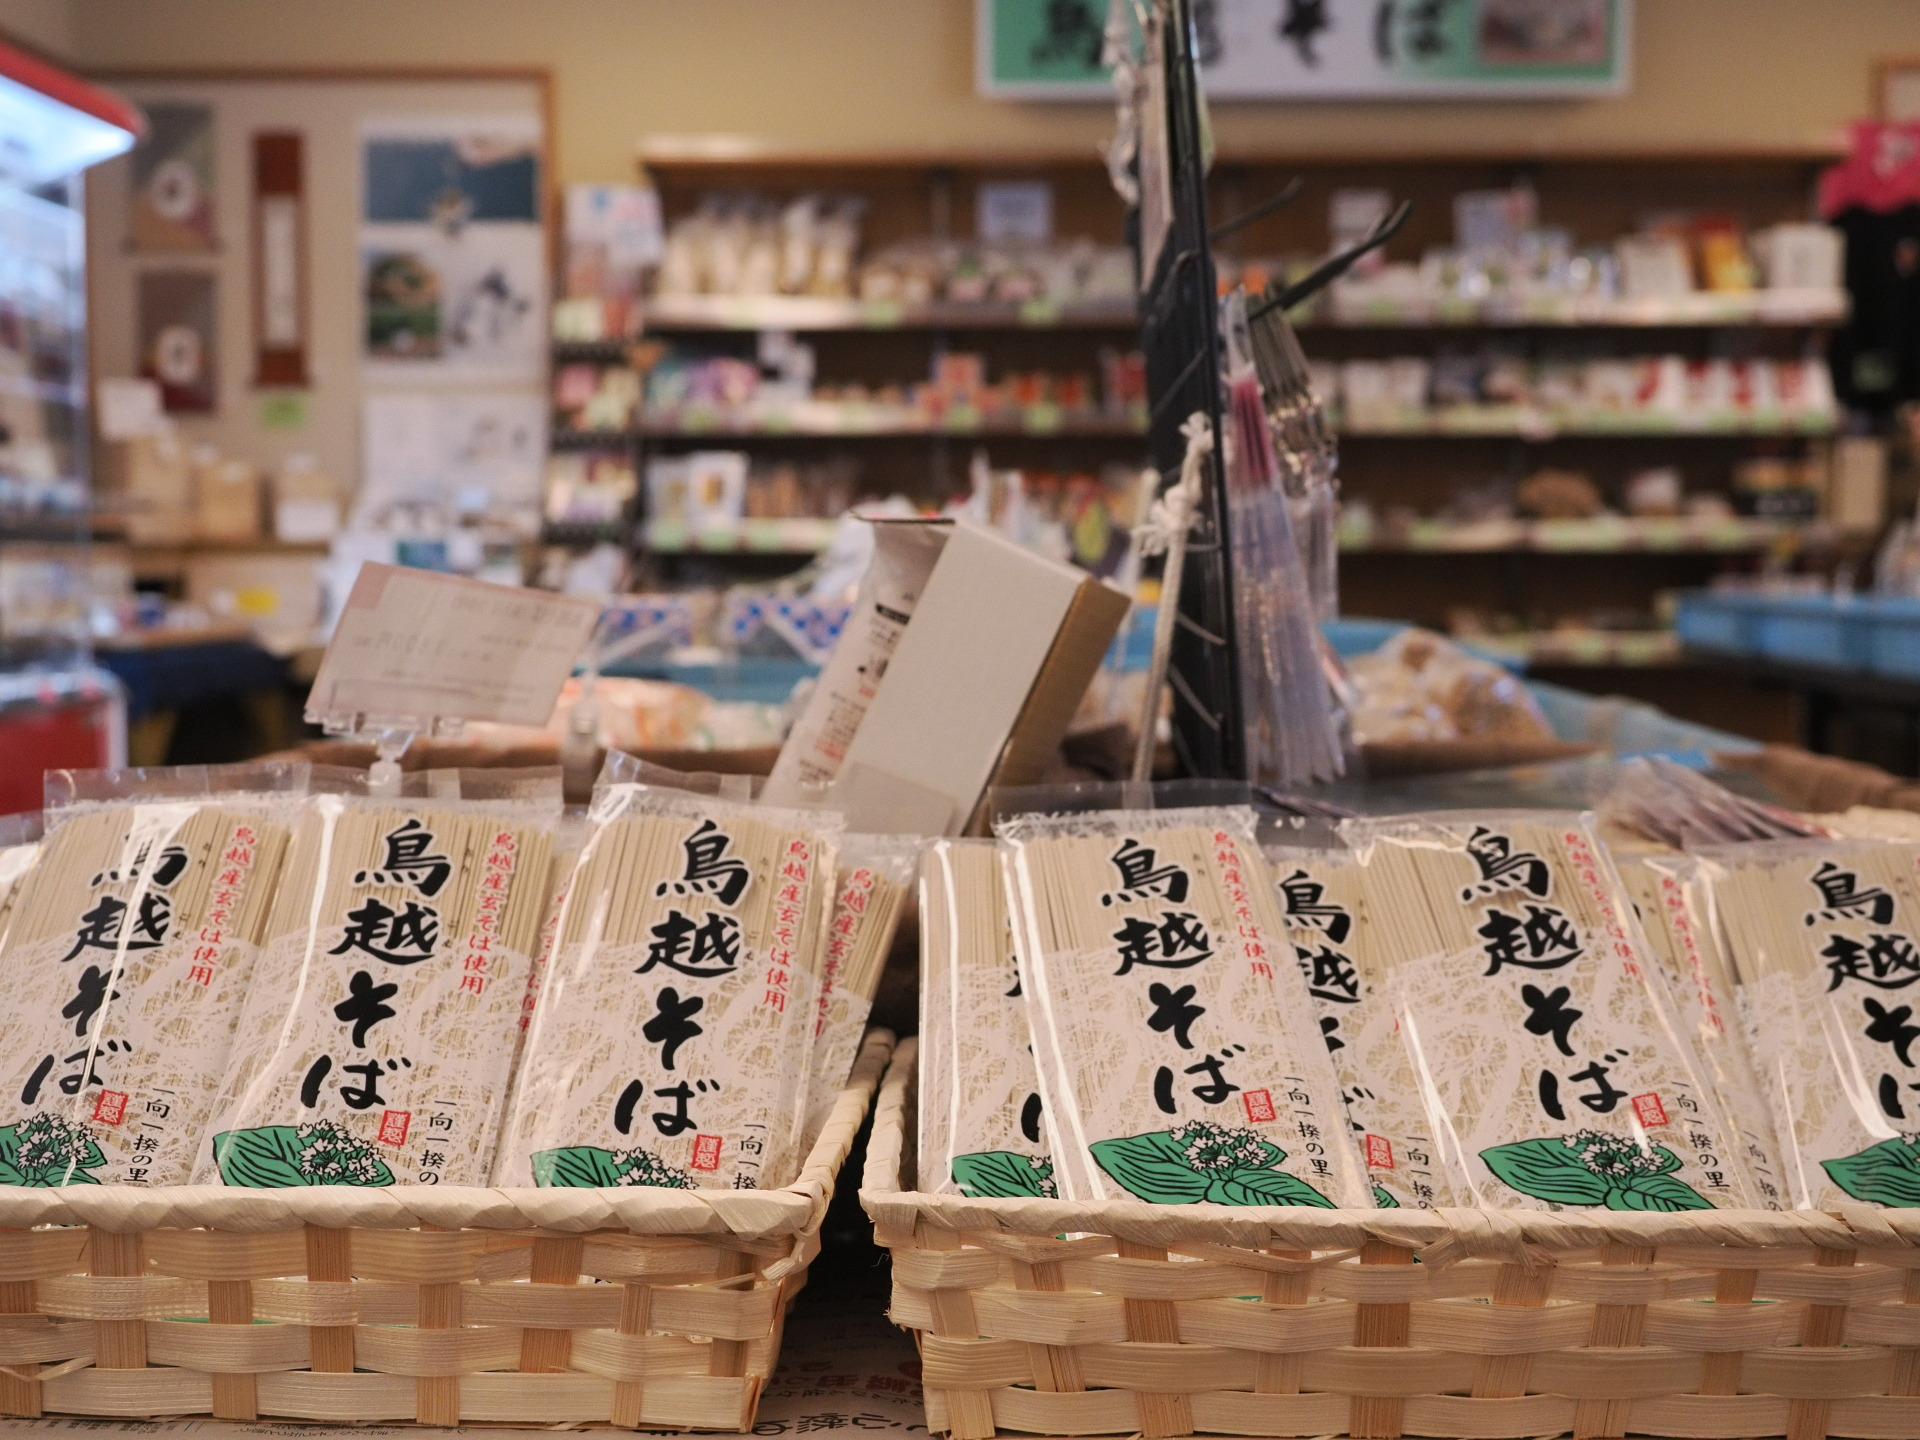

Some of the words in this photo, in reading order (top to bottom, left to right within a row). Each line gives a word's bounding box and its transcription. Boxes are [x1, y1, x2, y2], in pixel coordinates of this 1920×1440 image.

[186, 827, 256, 987] 鳥越産玄そば使用
[301, 819, 451, 1109] 鳥越そば
[459, 832, 516, 995] 鳥越産玄そば使用
[615, 820, 749, 1136] 鳥越そば
[762, 840, 809, 1013] 鳥越産玄そば使用
[1102, 839, 1245, 1114] 鳥越そば
[1214, 831, 1273, 980] 鳥越産玄そば使用
[1463, 827, 1629, 1121] 鳥越そば
[123, 1087, 175, 1183] 一向一揆の里
[1284, 1076, 1333, 1176] 一向一揆の里
[1671, 1081, 1731, 1188] 一向一揆の里
